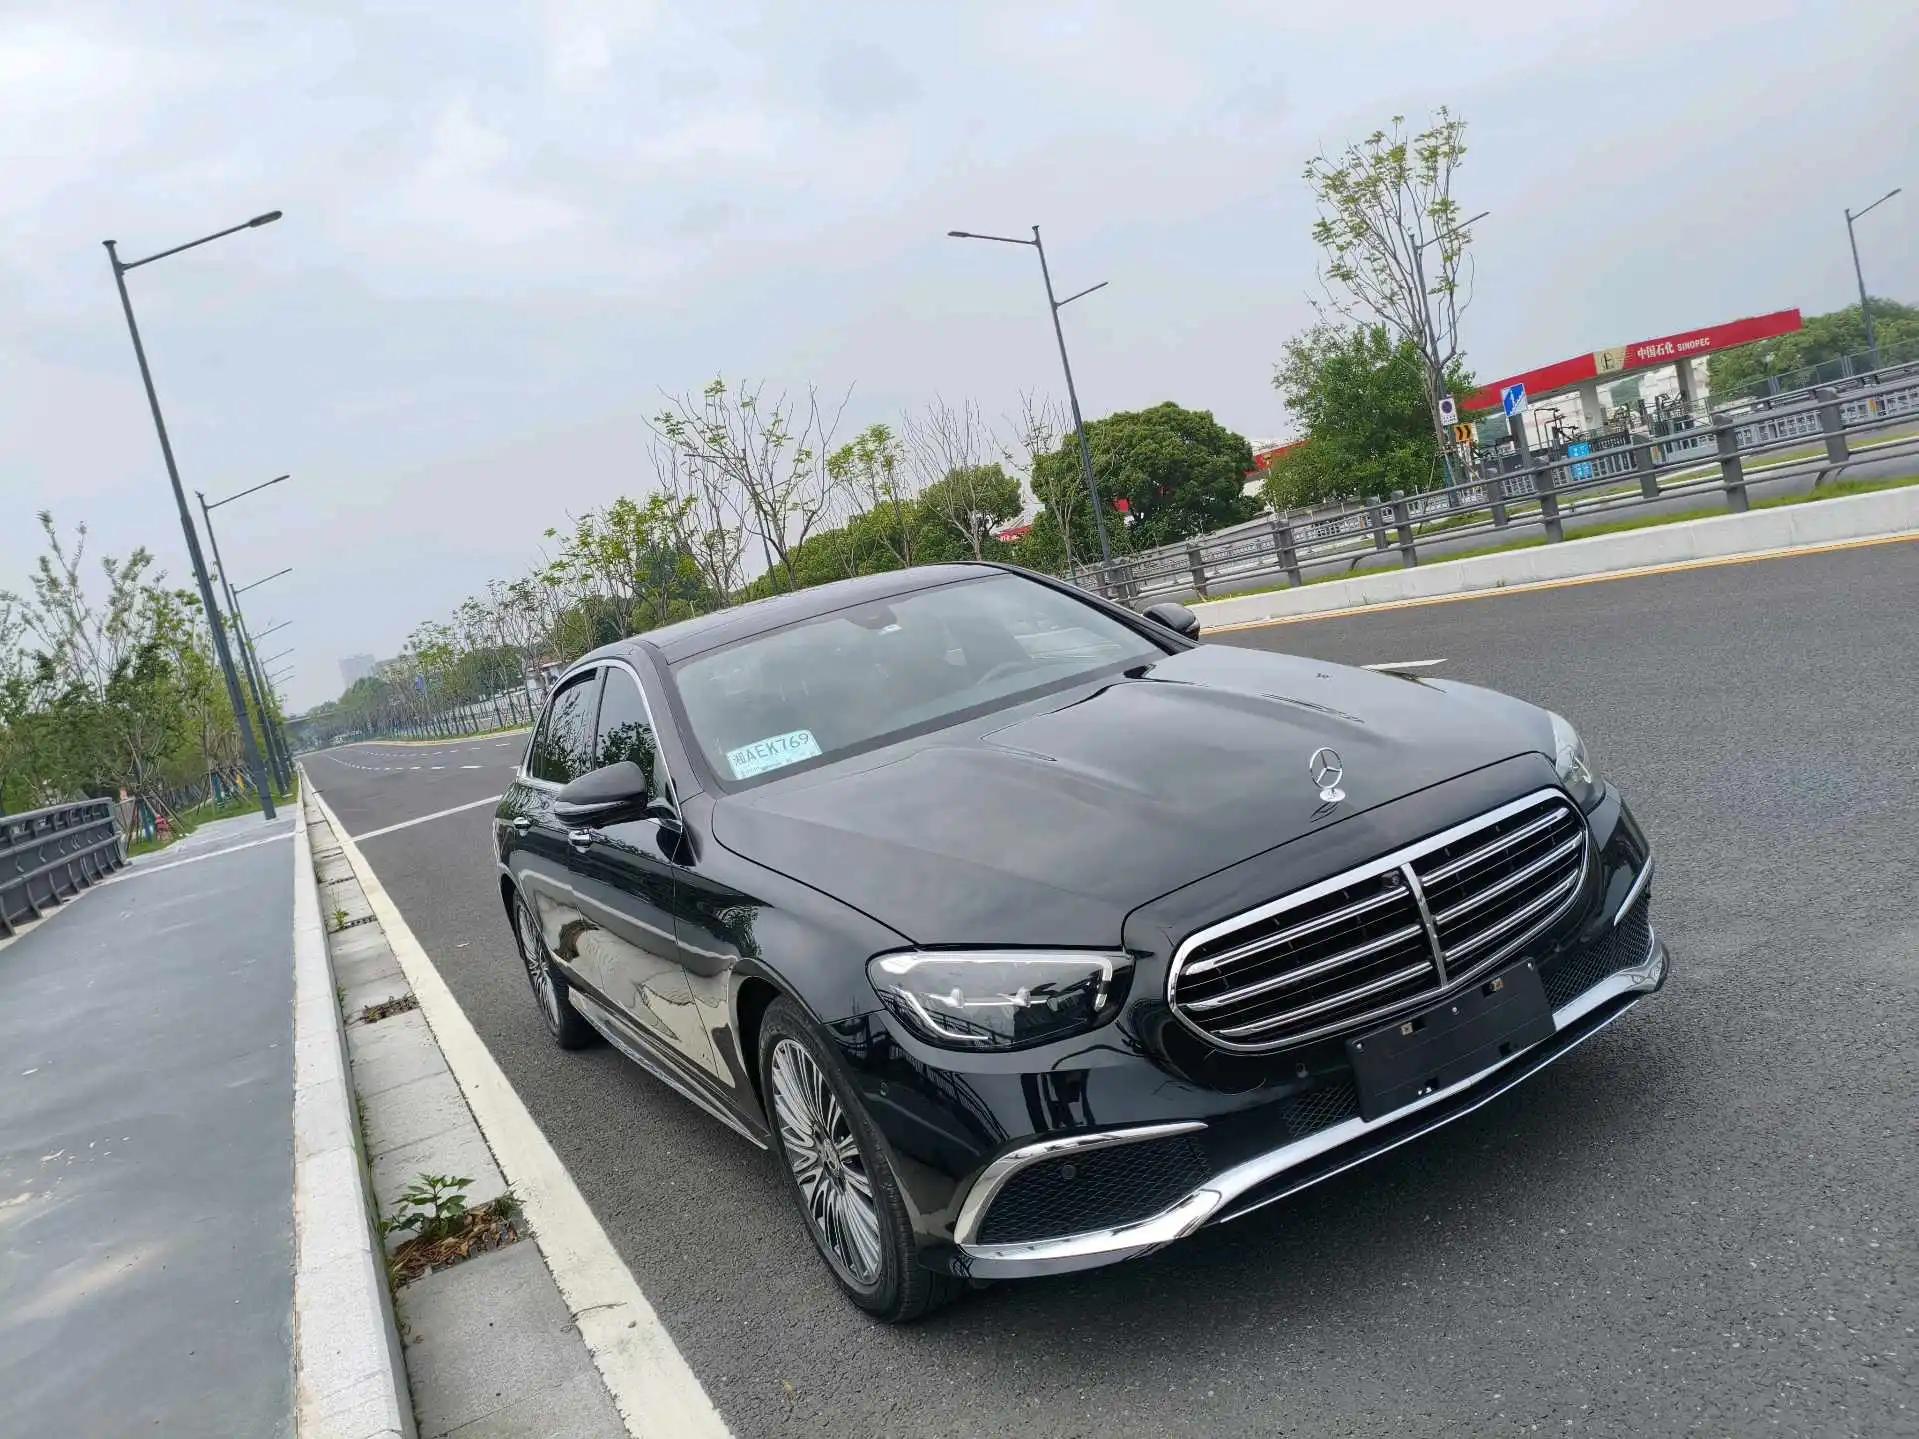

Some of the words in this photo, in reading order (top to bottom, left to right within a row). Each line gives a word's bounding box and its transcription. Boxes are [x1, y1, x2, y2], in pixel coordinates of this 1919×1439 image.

[1637, 341, 1675, 360] 中国石化
[1677, 337, 1711, 352] SINOPEC
